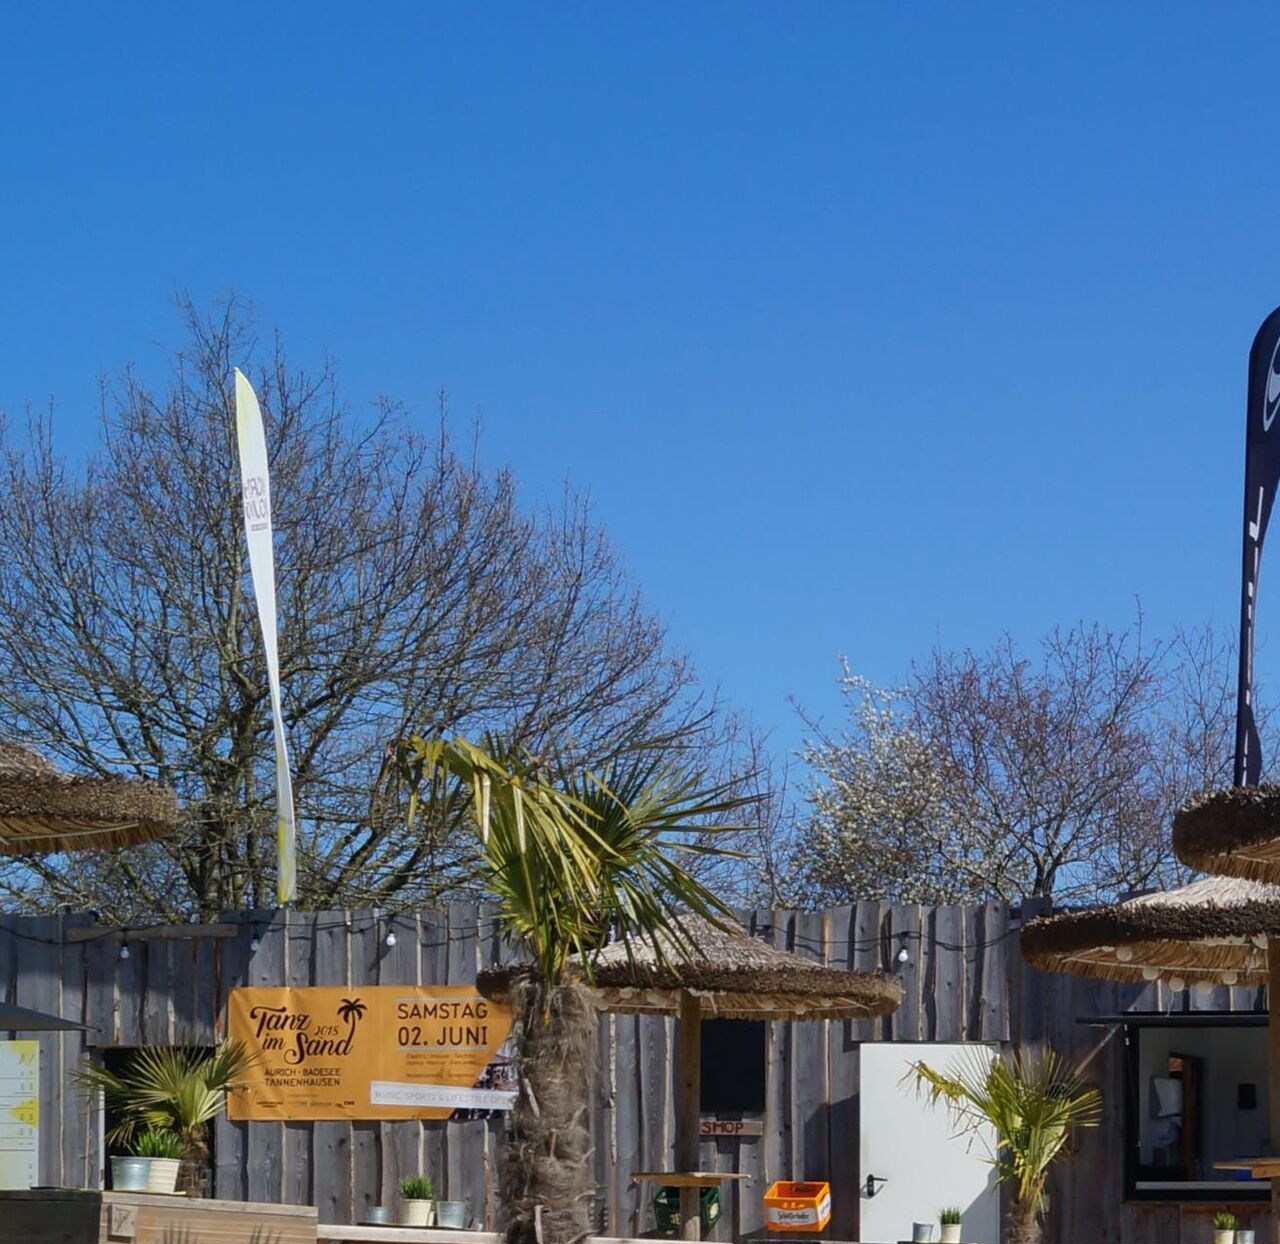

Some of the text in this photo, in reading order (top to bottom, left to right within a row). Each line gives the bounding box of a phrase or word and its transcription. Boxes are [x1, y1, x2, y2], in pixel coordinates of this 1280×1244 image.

[397, 1002, 488, 1020] SAMSTAG
[250, 1006, 312, 1039] Tanz
[398, 1026, 488, 1047] 02. JUNI
[262, 1031, 355, 1065] im Sand
[264, 1068, 296, 1077] AURICH
[303, 1067, 341, 1077] BADESEE
[265, 1078, 341, 1087] TANNENHAUSEN
[702, 1121, 744, 1134] SHOP
